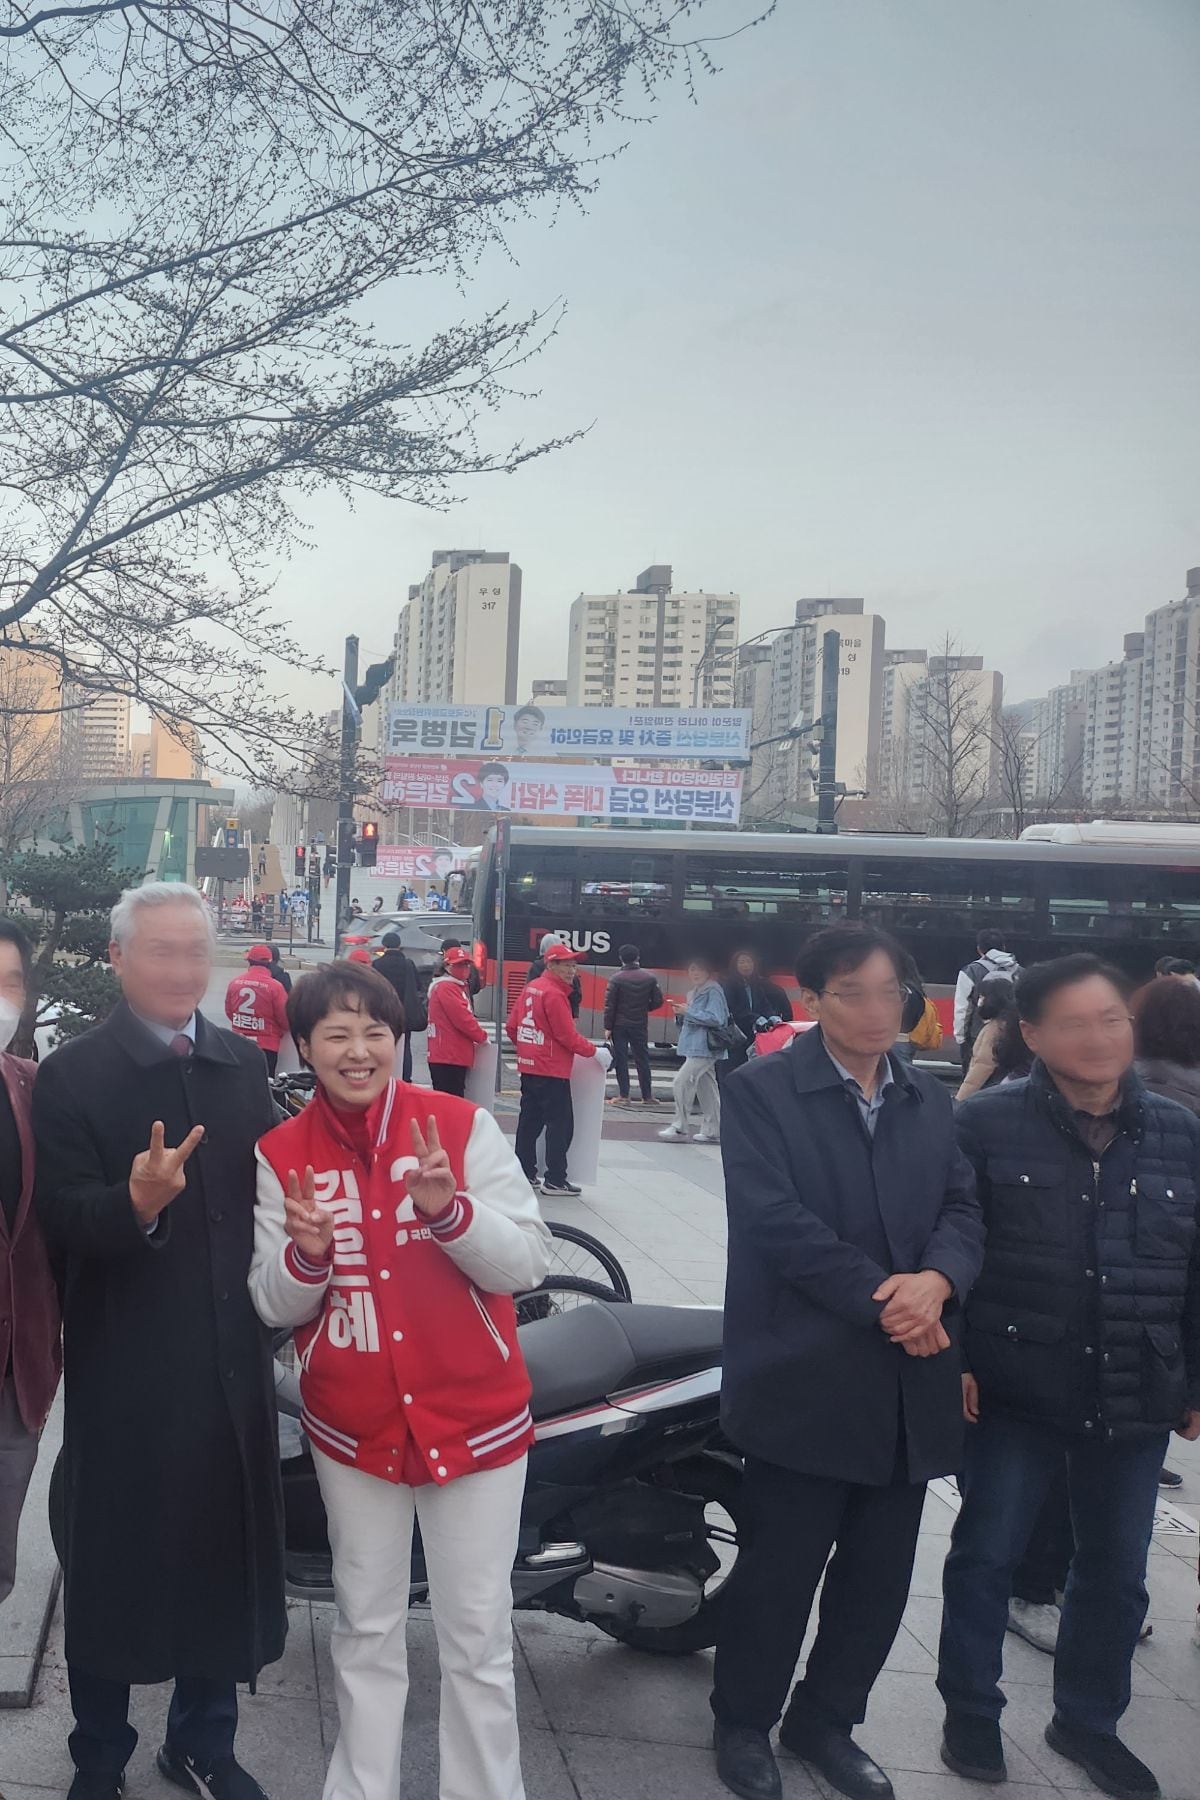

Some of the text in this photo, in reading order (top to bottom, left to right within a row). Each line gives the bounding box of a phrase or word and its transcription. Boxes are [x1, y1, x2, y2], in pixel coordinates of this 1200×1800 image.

[481, 601, 496, 610] 317
[839, 667, 850, 676] 19
[239, 987, 256, 1015] 2
[232, 1013, 265, 1031] 김은혜
[517, 1025, 545, 1046] 은혜
[410, 1226, 432, 1241] 국민
[313, 1168, 380, 1353] 김은혜
